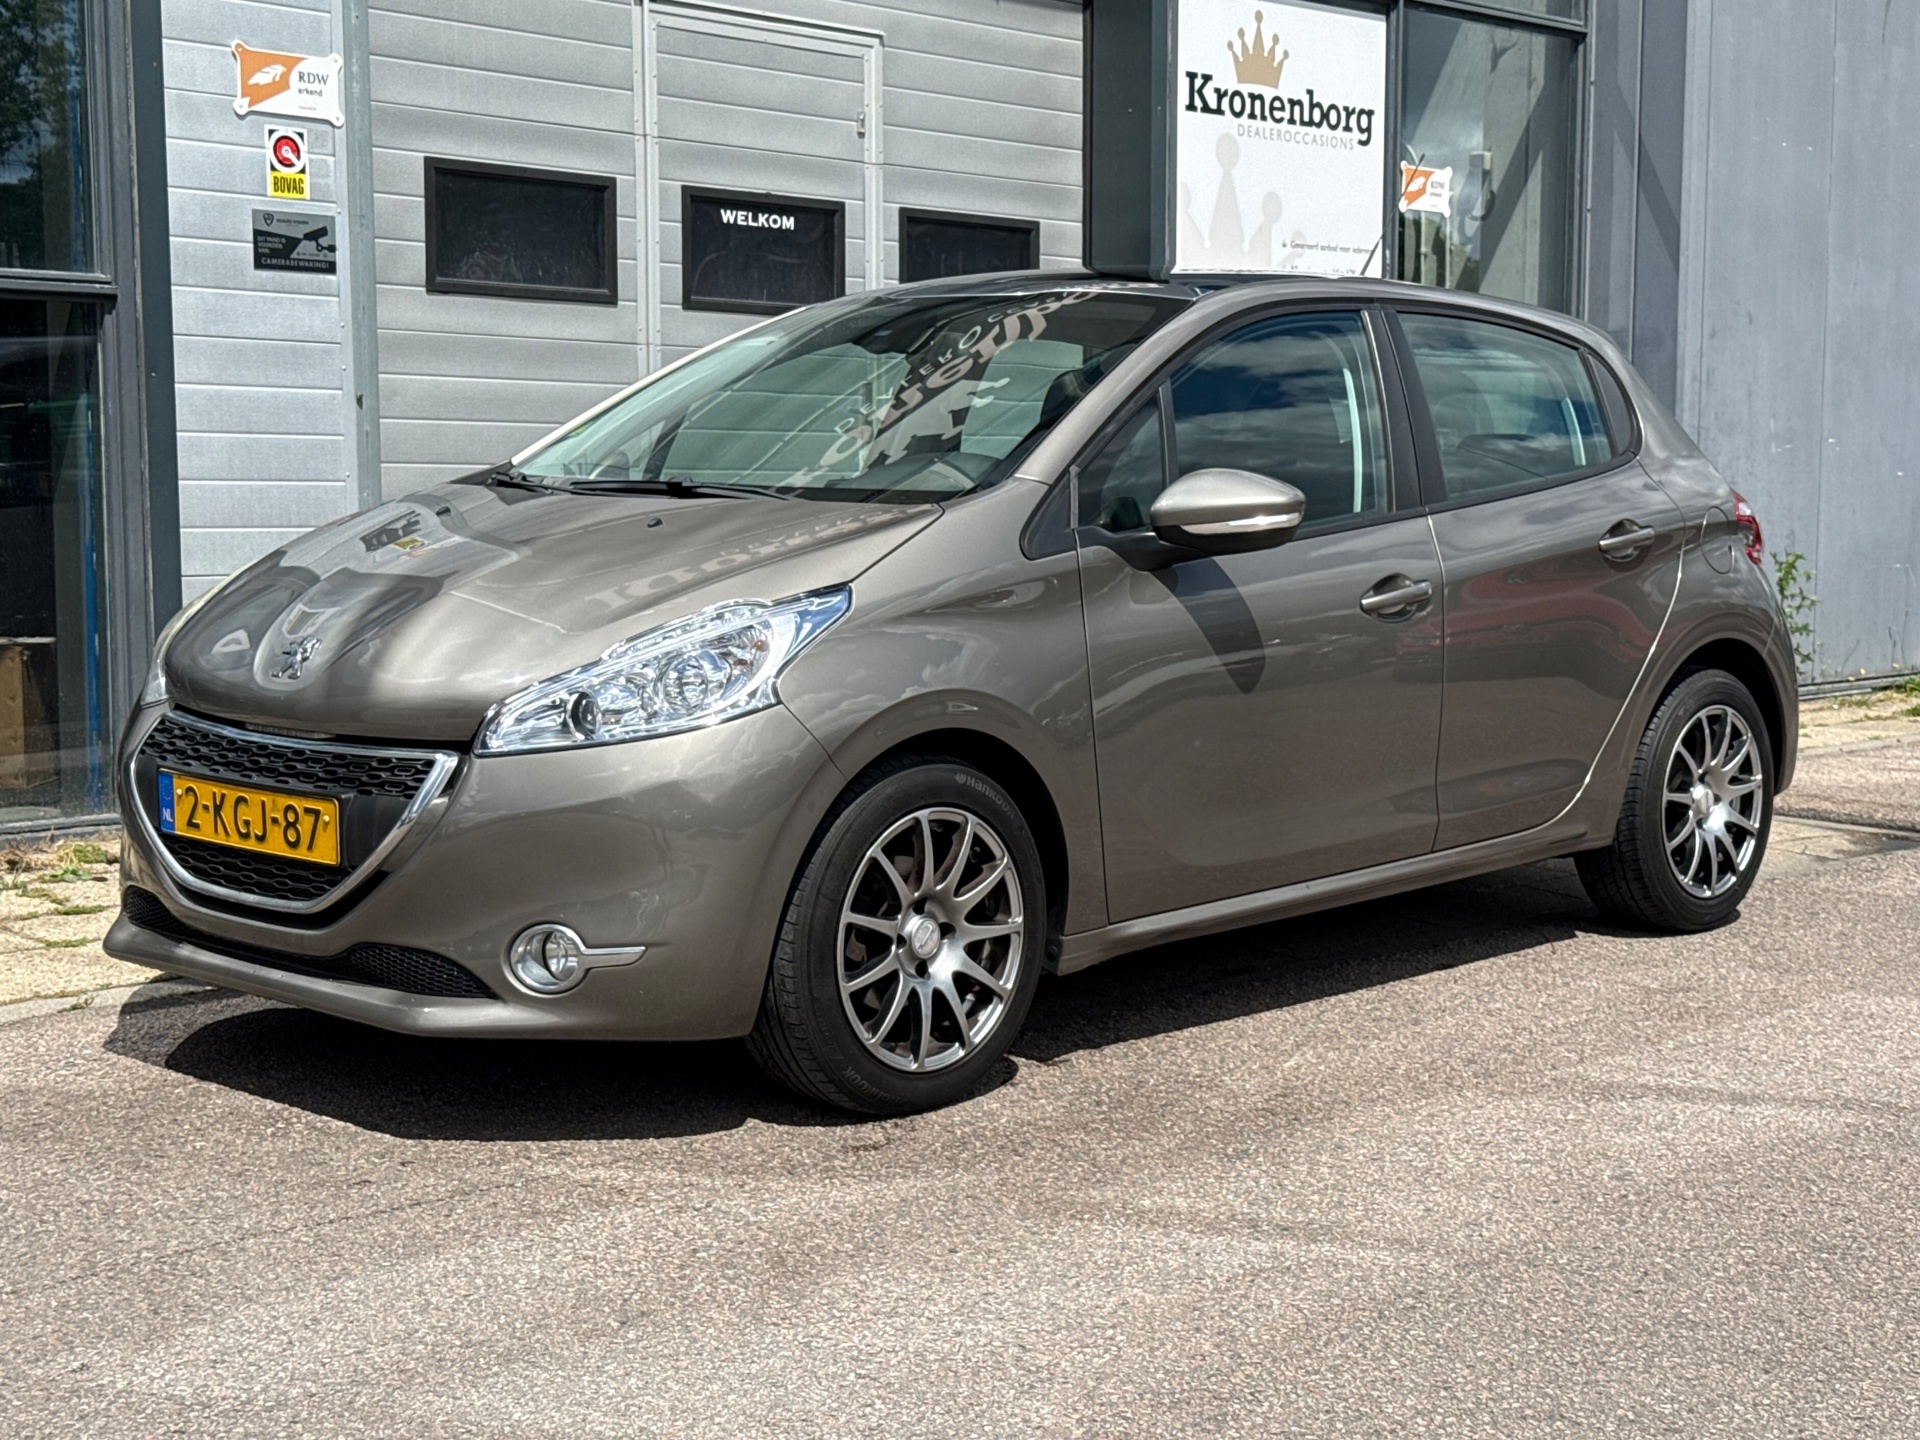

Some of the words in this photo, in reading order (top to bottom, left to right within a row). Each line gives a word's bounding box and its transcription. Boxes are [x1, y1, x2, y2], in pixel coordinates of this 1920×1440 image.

[298, 71, 329, 86] RDW
[298, 87, 323, 97] erkend
[1185, 71, 1375, 147] Kronenborg
[1237, 123, 1355, 151] DEALEROCCASIONS
[273, 175, 304, 195] BOVAG
[720, 208, 795, 231] WELKOM
[162, 807, 174, 822] NL
[184, 783, 322, 853] 2-KGJ-87
